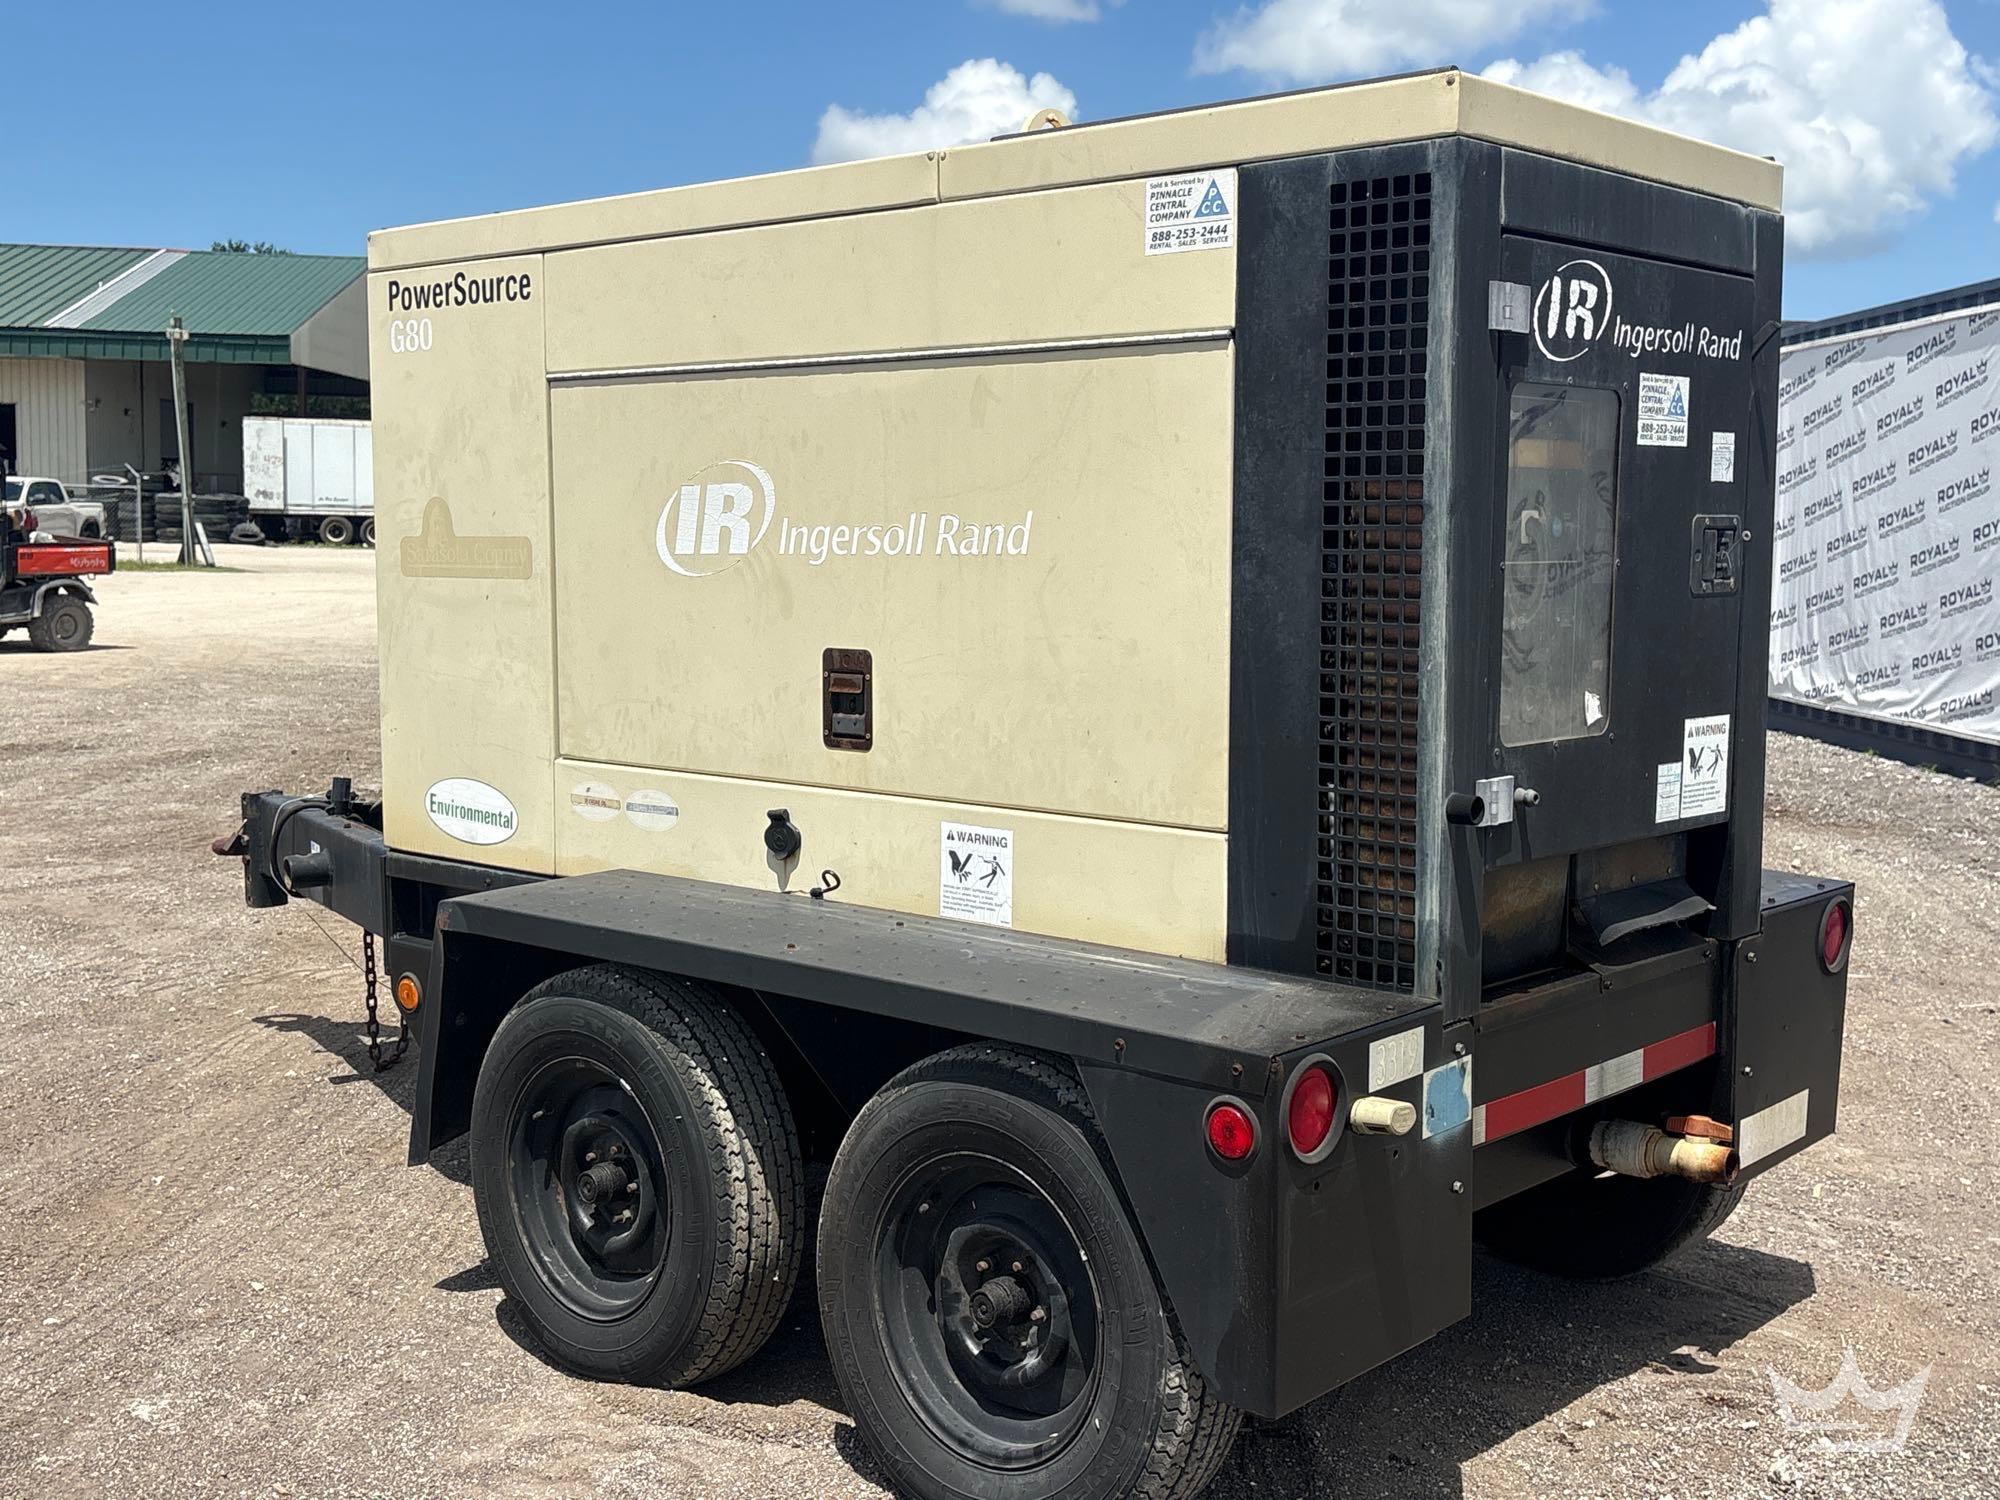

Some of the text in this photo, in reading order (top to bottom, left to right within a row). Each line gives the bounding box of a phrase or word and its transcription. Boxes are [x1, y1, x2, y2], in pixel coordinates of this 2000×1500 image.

[1150, 188, 1192, 200] PINNACLE
[1150, 200, 1187, 211] CENTRAL
[1208, 188, 1217, 200] P
[1150, 210, 1191, 222] COMPANY
[1149, 236, 1228, 250] RENTAL SALES SERVICE
[1151, 224, 1227, 242] 888-253-2444
[389, 272, 531, 311] PowerSource
[1548, 276, 1742, 361] IR Ingersoll Rand
[1970, 315, 1999, 336] AUCTION
[391, 318, 432, 353] G80
[1825, 340, 1859, 369] ROYAL
[1907, 333, 1945, 365] ROYAL
[1780, 372, 1808, 399] ROYAL
[1852, 369, 1885, 398] ROYAL
[1936, 368, 1976, 399] ROYAL
[1803, 402, 1833, 428] ROYAL
[1877, 403, 1913, 432] ROYAL
[1971, 408, 2000, 434] ROY
[1826, 434, 1857, 460] ROYAL
[1908, 437, 1946, 466] ROYAL
[1779, 462, 1808, 487] ROYAL
[1852, 468, 1886, 494] ROYAL
[1937, 475, 1978, 504] ROYAL
[1804, 495, 1834, 518] ROYAL
[1878, 504, 1915, 530] ROYAL
[675, 483, 1033, 565] IR Ingersoll Rand
[1973, 519, 2000, 542] ROY
[1827, 530, 1858, 554] ROYAL
[1780, 553, 1809, 576] ROYAL
[1910, 542, 1948, 568] ROYAL
[1854, 567, 1888, 589] ROYAL
[1806, 589, 1835, 610] ROYAL
[1940, 584, 1980, 608] ROYAL
[1771, 608, 1789, 622] YAL
[1880, 607, 1917, 630] ROYAL
[1829, 627, 1859, 648] ROYAL
[1781, 644, 1811, 664] ROYAL
[1912, 648, 1951, 670] ROYAL
[1855, 666, 1890, 686] ROYAL
[1940, 694, 1981, 713] ROYAL
[1695, 723, 1726, 737] WARNING
[430, 793, 514, 830] Environmental
[956, 831, 1008, 848] WARNING
